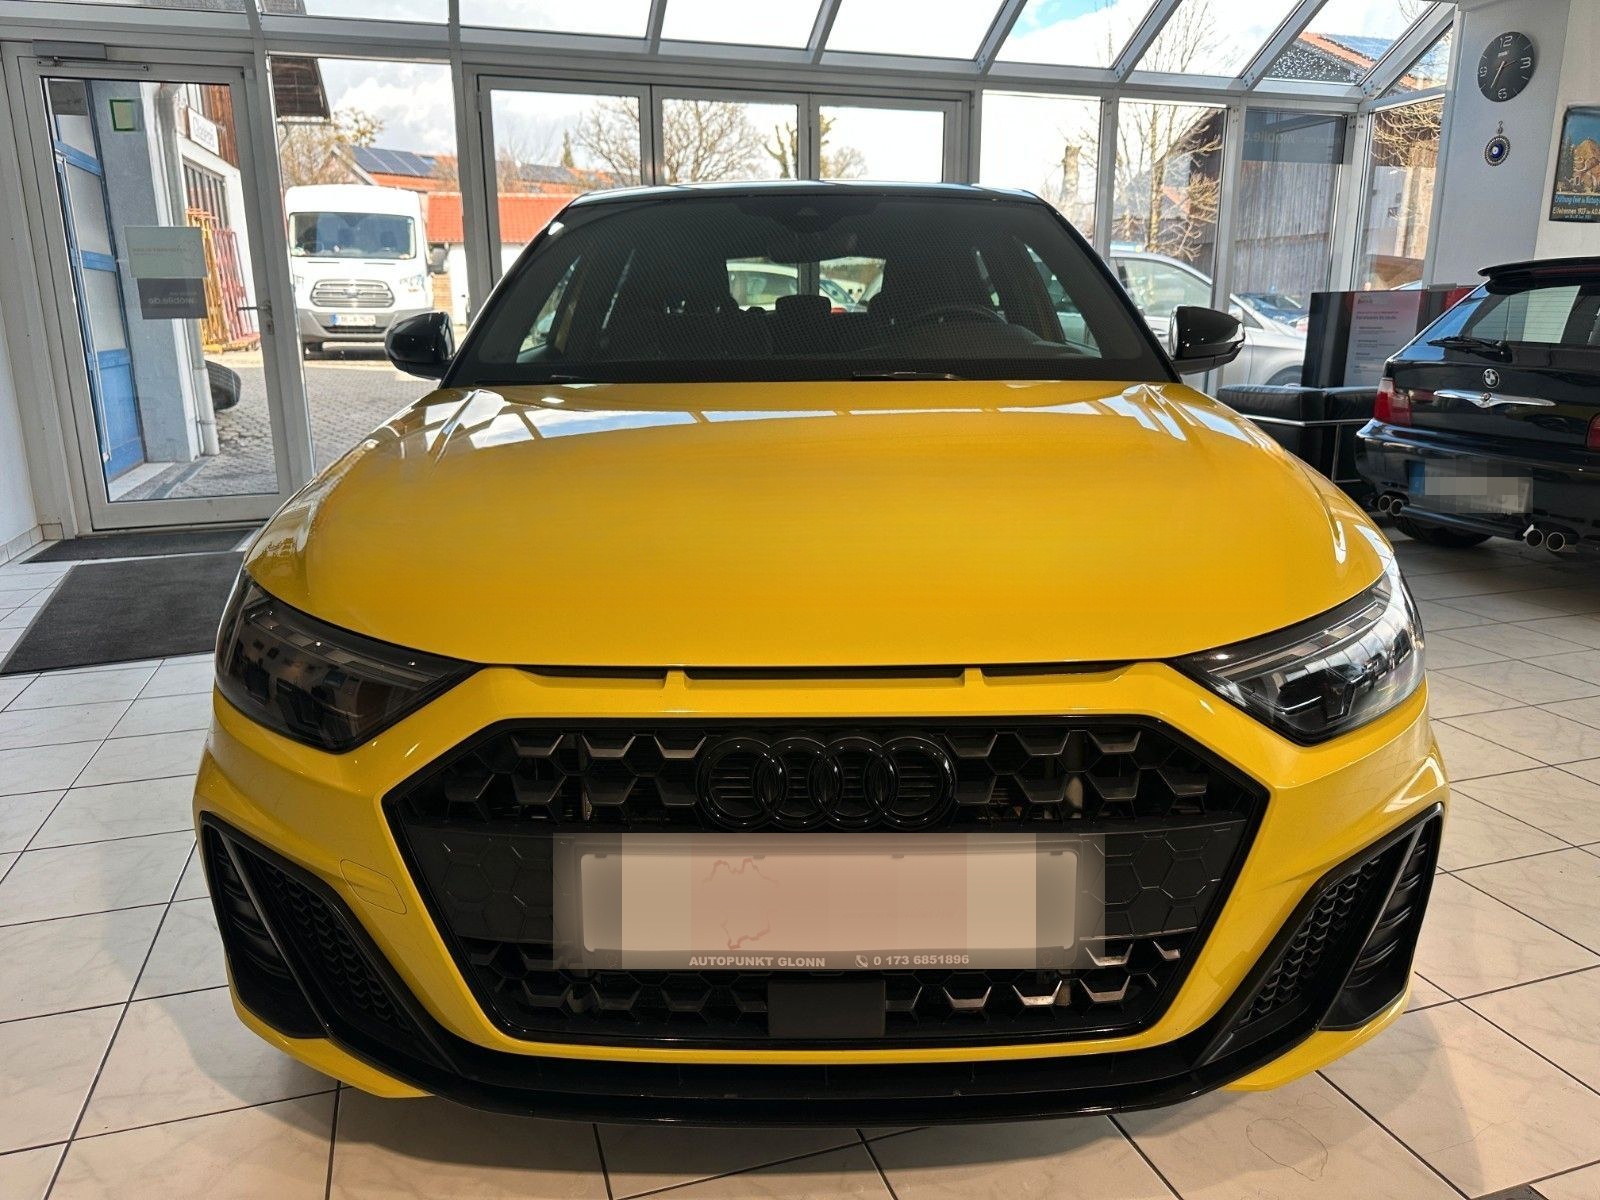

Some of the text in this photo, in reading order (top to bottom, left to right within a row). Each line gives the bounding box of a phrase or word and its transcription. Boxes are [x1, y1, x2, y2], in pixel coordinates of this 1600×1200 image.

[1499, 35, 1513, 48] 12
[1520, 56, 1532, 69] 3
[1479, 66, 1488, 78] 9
[1497, 87, 1508, 99] 6
[688, 954, 970, 967] AUTOPUNKT GLONN 0 173 6851896
